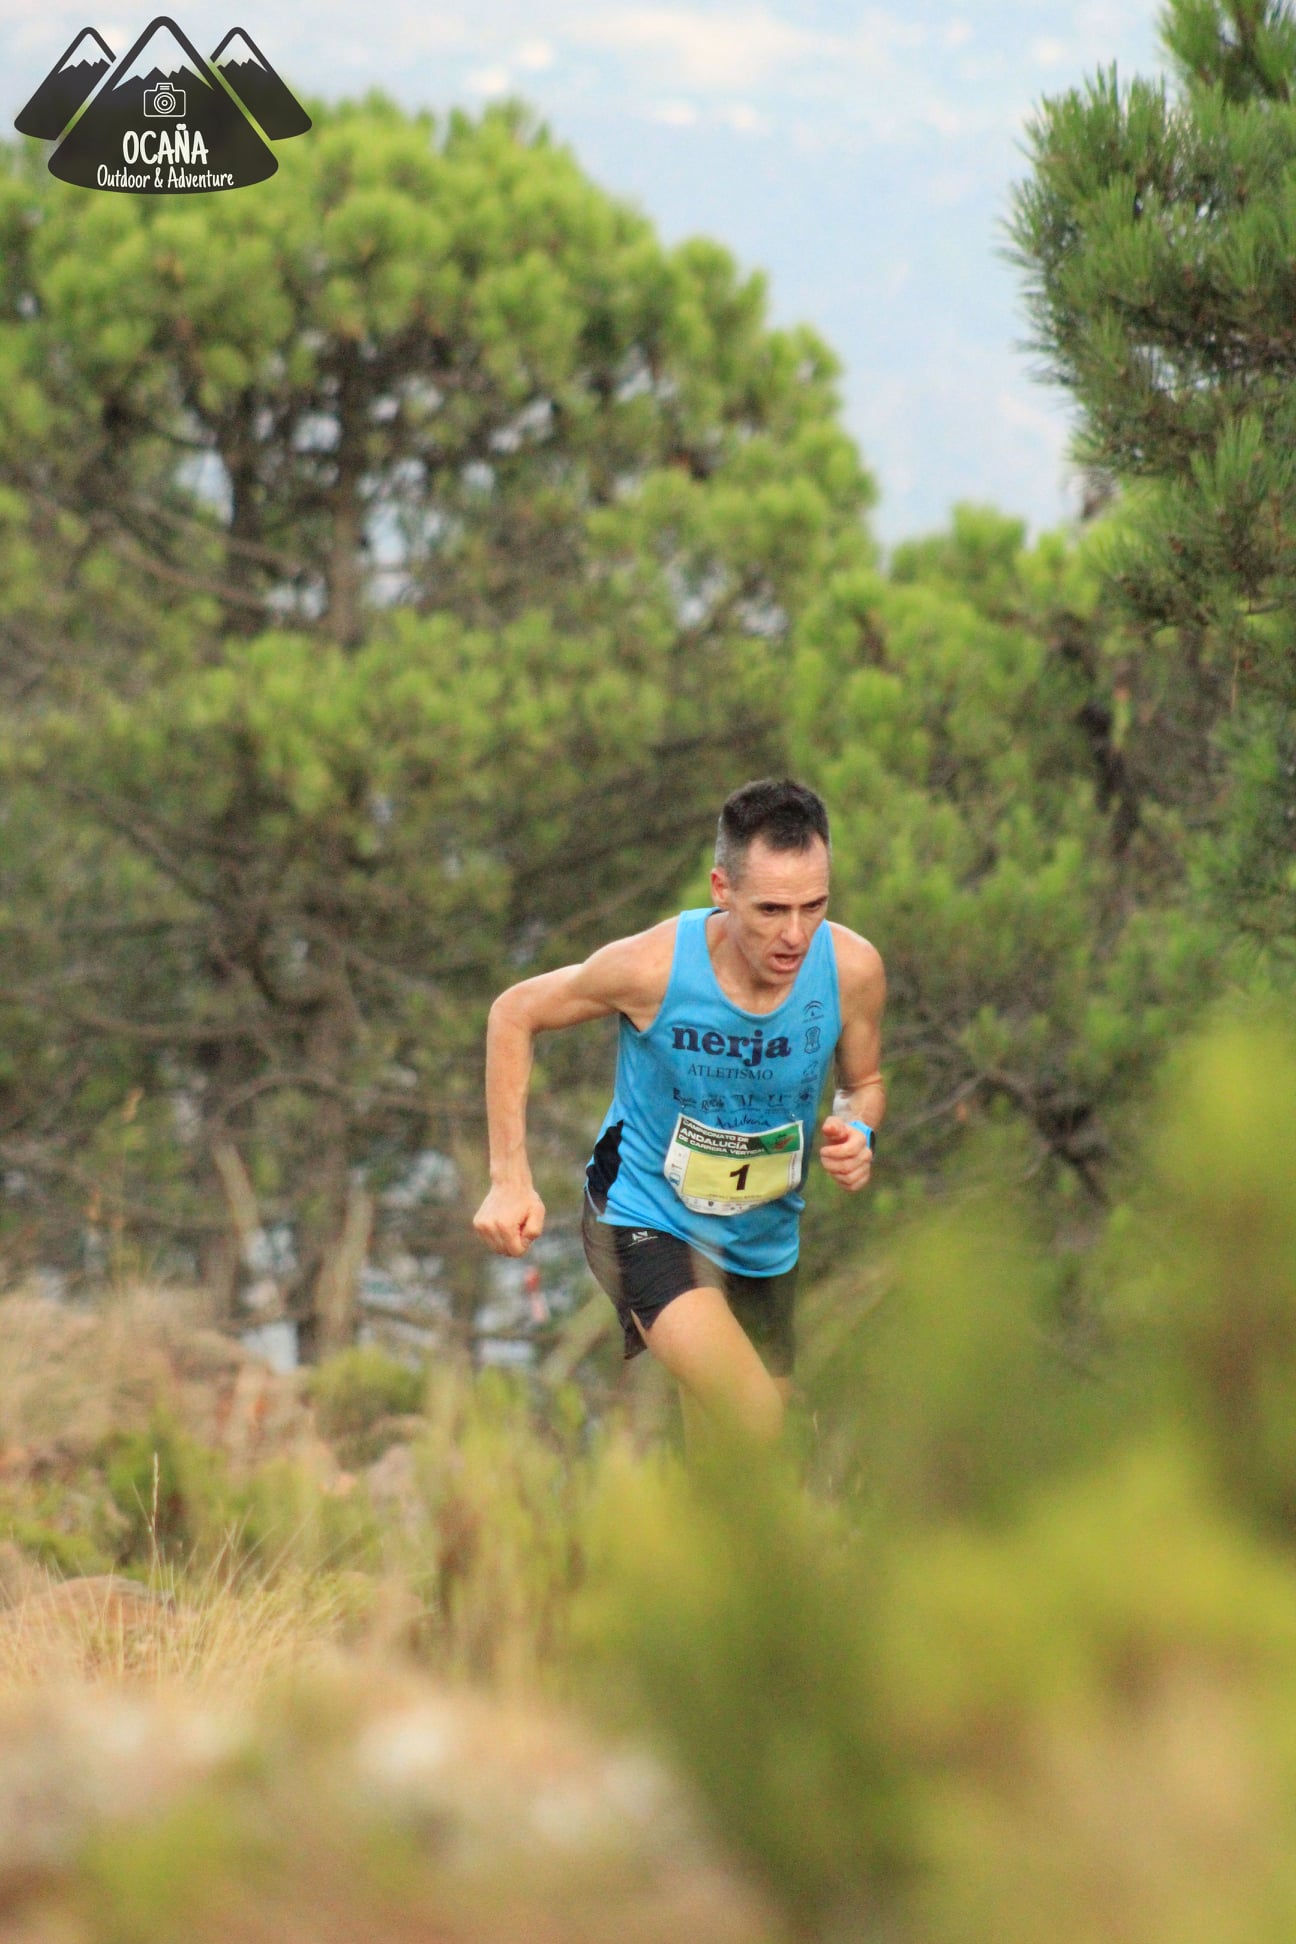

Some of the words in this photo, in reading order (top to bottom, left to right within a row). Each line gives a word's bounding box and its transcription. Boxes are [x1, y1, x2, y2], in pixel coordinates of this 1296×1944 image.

[672, 1026, 792, 1067] nerja
[688, 1063, 774, 1081] ATLETISMO
[680, 1127, 748, 1150] ANDALUCÍA
[683, 1120, 736, 1141] CAMPEONATO
[689, 1140, 728, 1153] CARRERA
[730, 1163, 751, 1191] 1
